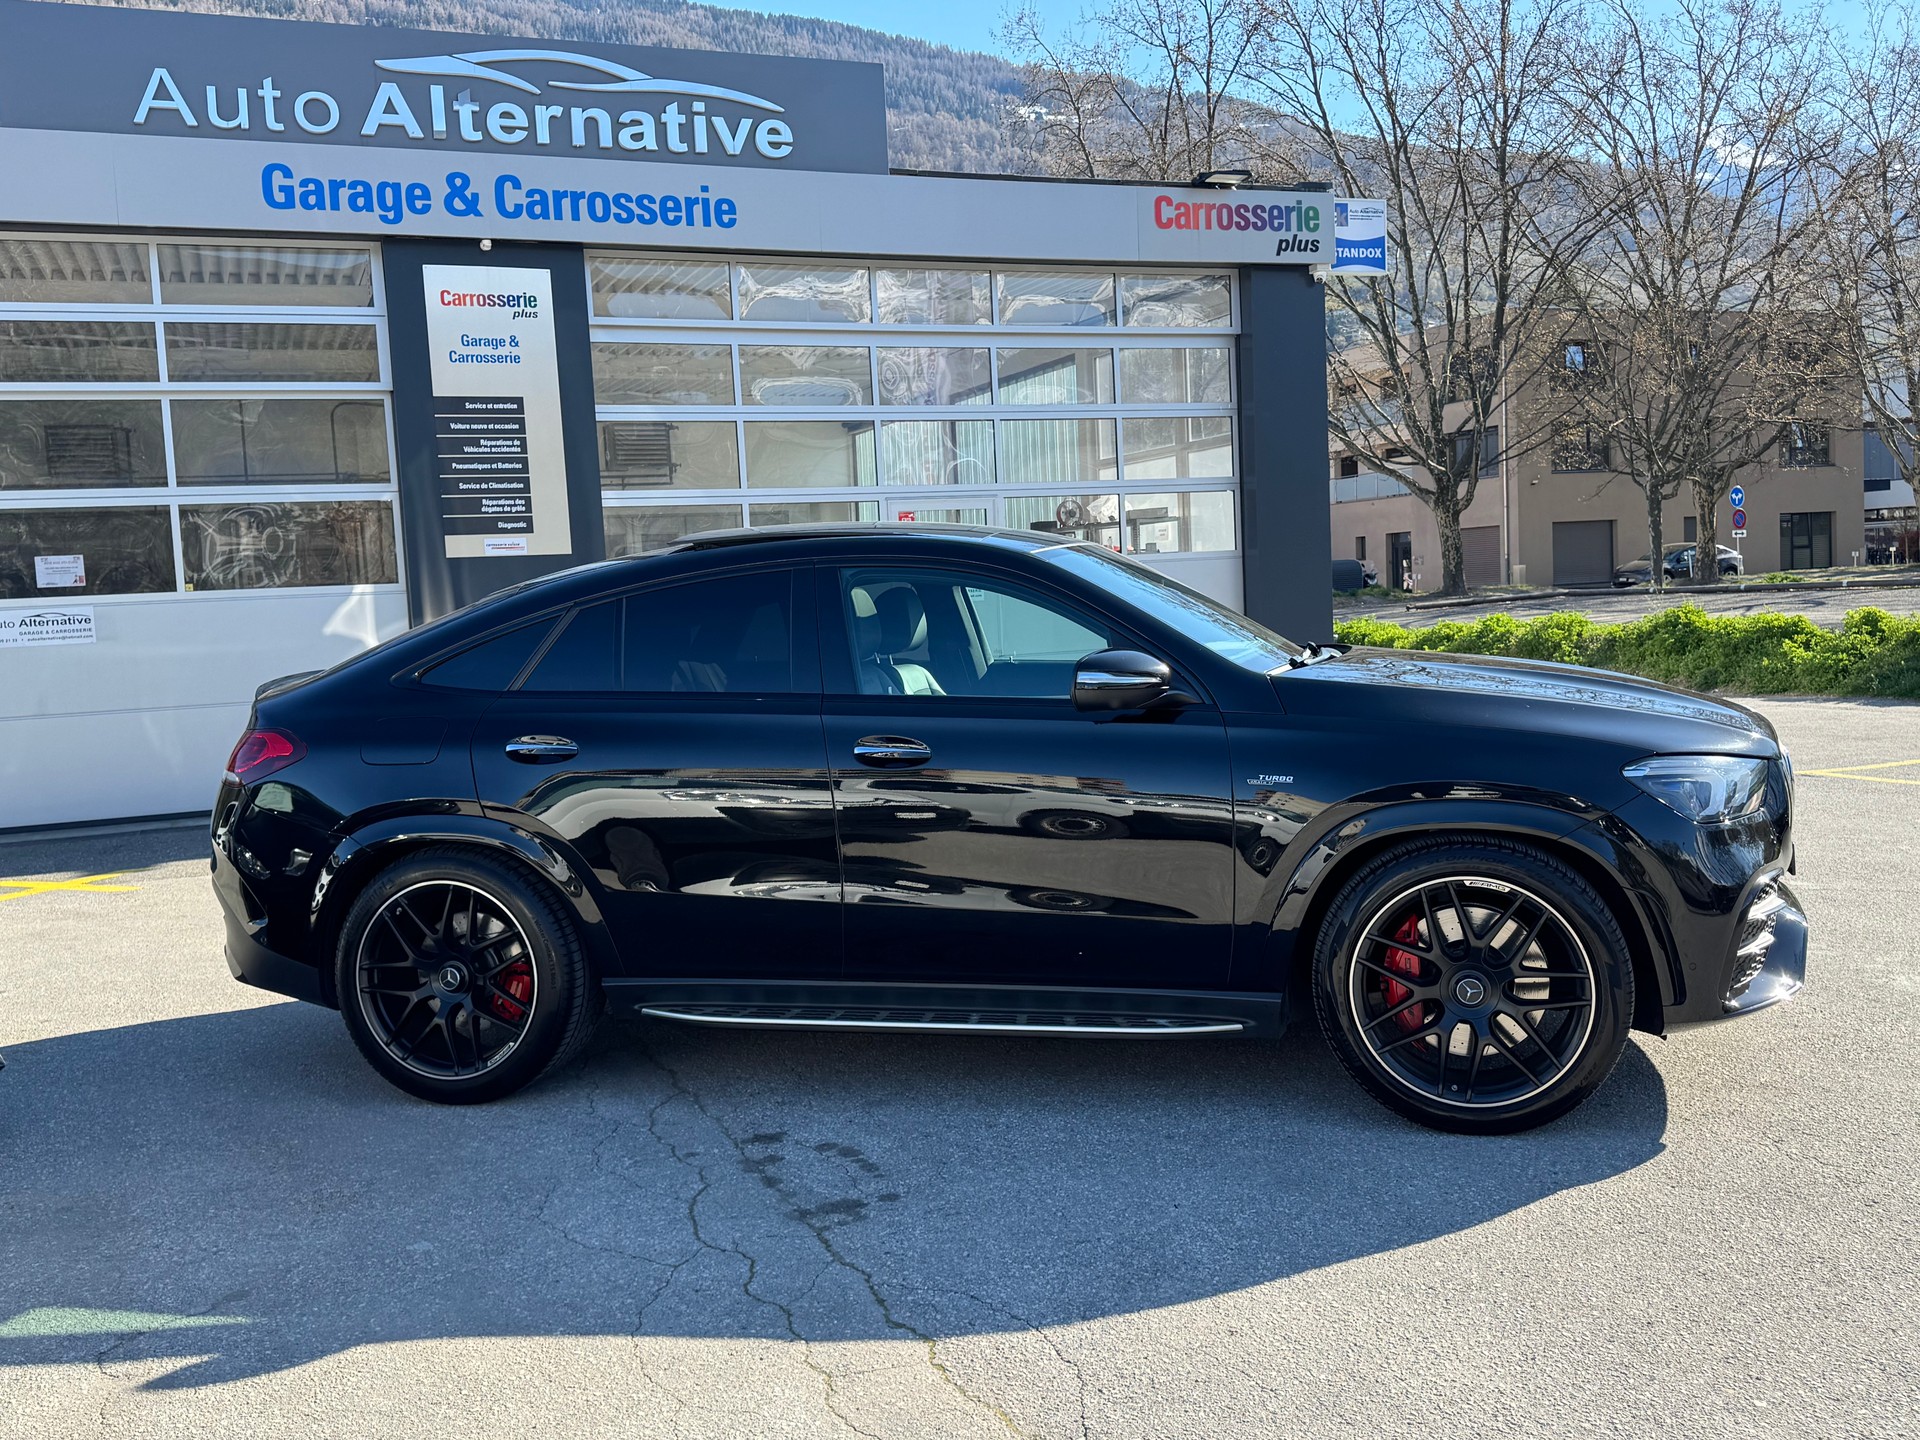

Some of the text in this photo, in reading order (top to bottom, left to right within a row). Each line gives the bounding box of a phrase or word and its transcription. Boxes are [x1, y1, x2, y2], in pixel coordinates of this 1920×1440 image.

[133, 67, 794, 159] Auto Alternative
[261, 162, 737, 229] Garage & Carrosserie
[1154, 195, 1320, 232] Carrosserie
[1276, 234, 1320, 256] plus
[440, 290, 538, 308] Carrosserie
[512, 309, 538, 320] plus
[461, 334, 520, 350] Garage &
[449, 350, 520, 364] Carrosserie
[19, 616, 91, 628] Alternative
